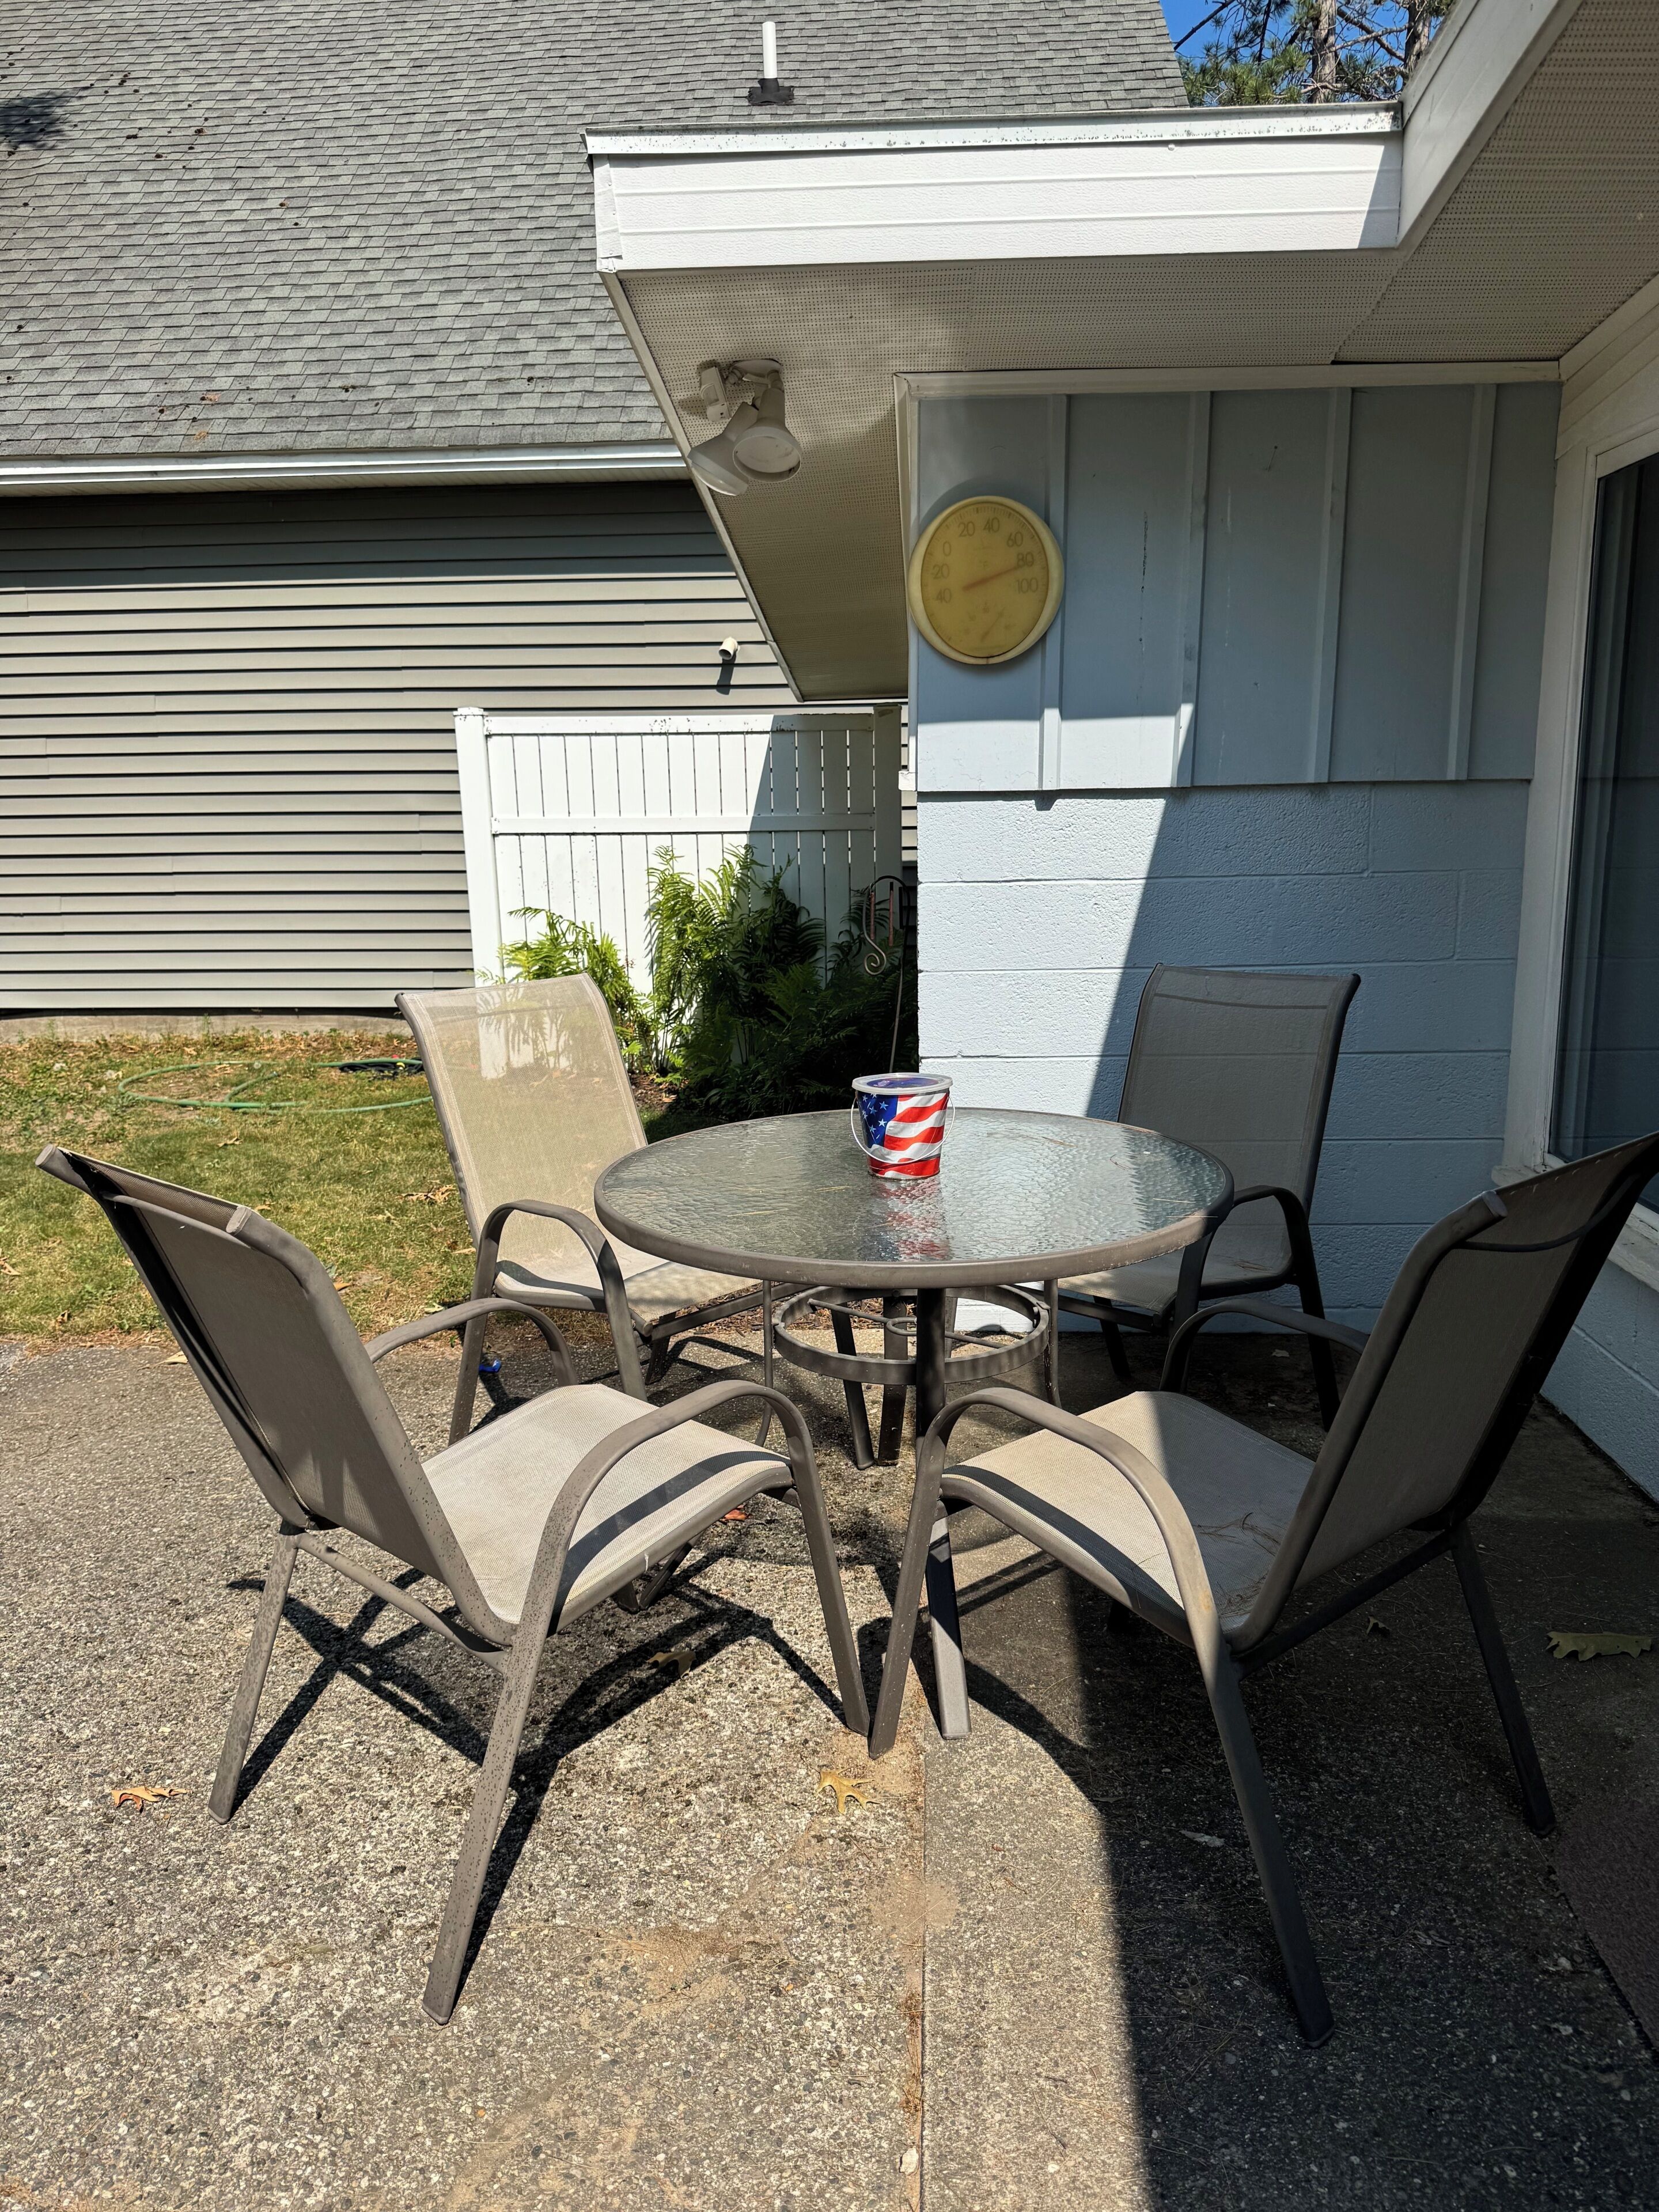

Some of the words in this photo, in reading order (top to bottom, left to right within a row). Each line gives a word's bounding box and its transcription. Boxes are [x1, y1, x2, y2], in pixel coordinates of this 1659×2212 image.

[958, 521, 975, 537] 20
[983, 517, 1000, 533] 40
[1006, 532, 1023, 547] 60
[943, 541, 952, 556] 0
[1017, 552, 1035, 567] 80
[1016, 577, 1039, 593] 100
